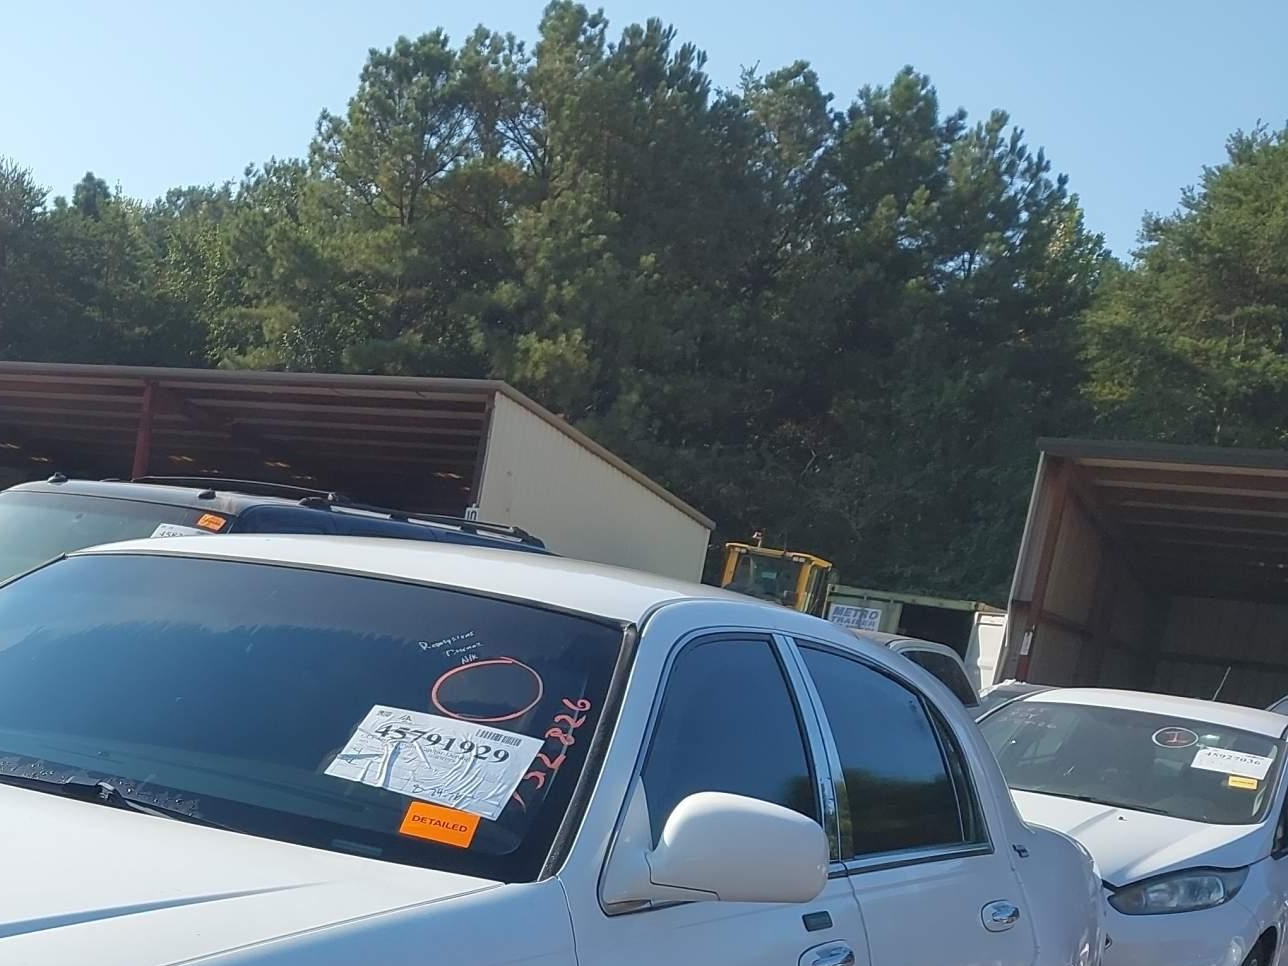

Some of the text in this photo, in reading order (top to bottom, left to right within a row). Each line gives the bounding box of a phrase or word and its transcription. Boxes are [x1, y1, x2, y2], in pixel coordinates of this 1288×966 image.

[833, 606, 879, 620] METRO
[374, 724, 510, 763] 45791929
[412, 814, 468, 832] DETAILED
